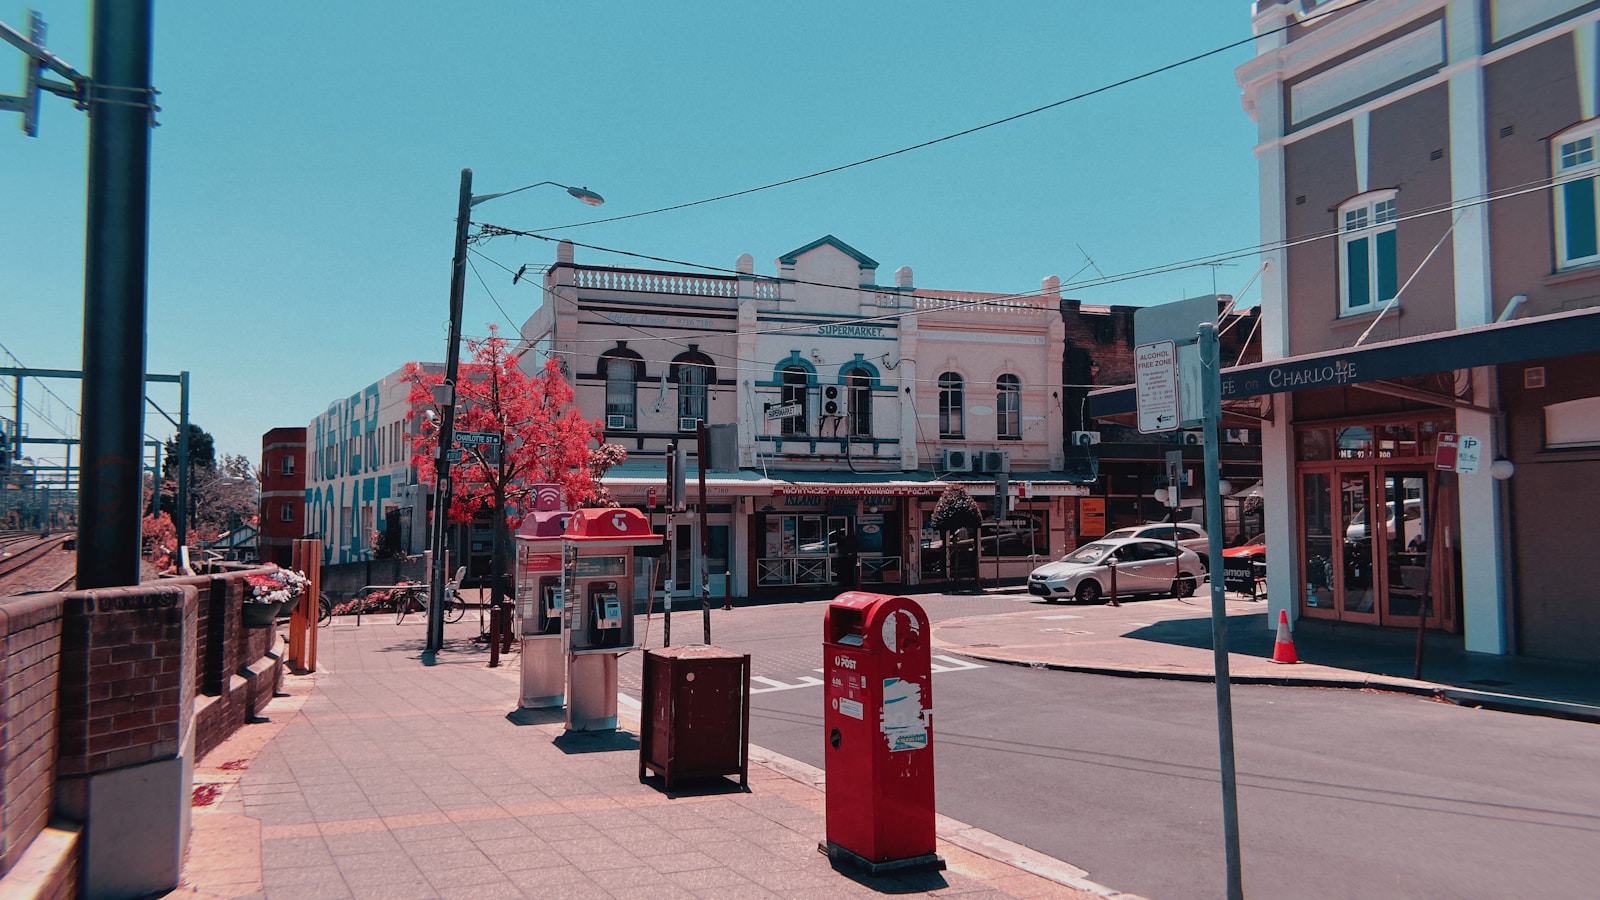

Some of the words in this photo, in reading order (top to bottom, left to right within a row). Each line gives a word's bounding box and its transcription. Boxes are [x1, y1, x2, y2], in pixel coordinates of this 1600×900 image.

[1140, 351, 1170, 360] ALCOHOL
[1155, 358, 1172, 367] ZONE
[313, 383, 380, 483] NEVER
[456, 434, 485, 443] CHARLOTTE
[1444, 434, 1454, 442] NO
[1464, 440, 1477, 449] 1P
[784, 496, 821, 506] ISLAND
[304, 484, 335, 565] TOO
[339, 475, 391, 565] LATE
[840, 658, 857, 670] POST
